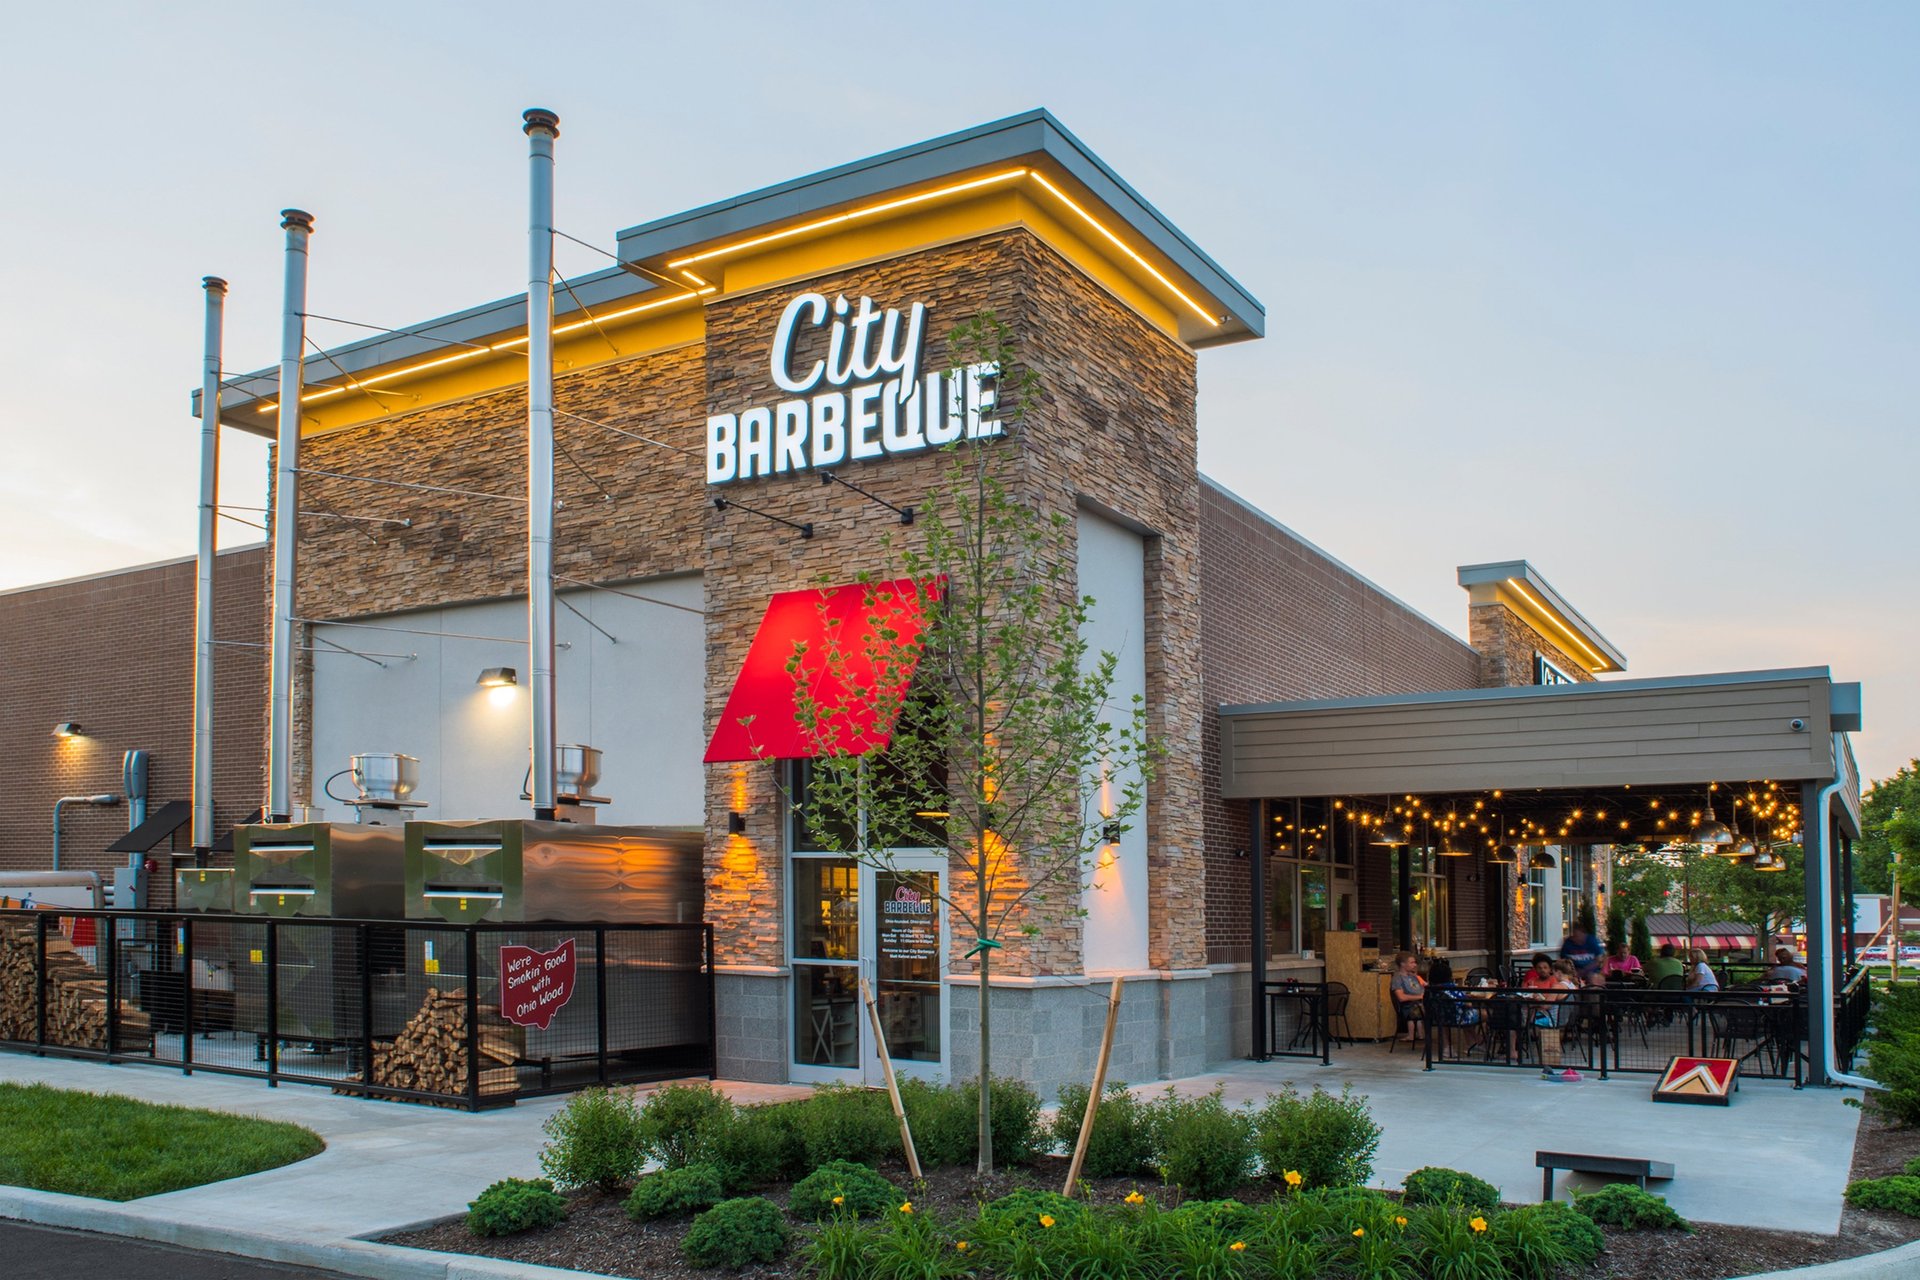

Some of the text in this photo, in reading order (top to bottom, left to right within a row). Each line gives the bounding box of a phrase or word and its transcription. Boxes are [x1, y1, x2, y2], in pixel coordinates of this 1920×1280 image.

[771, 293, 924, 405] City
[707, 360, 1001, 485] BARBEQUE
[884, 901, 931, 914] BARBEQUE
[895, 886, 921, 907] City
[507, 955, 532, 973] We're
[508, 950, 567, 989] Smokin' Good
[531, 975, 551, 993] with
[516, 982, 564, 1017] Ohio Wood
